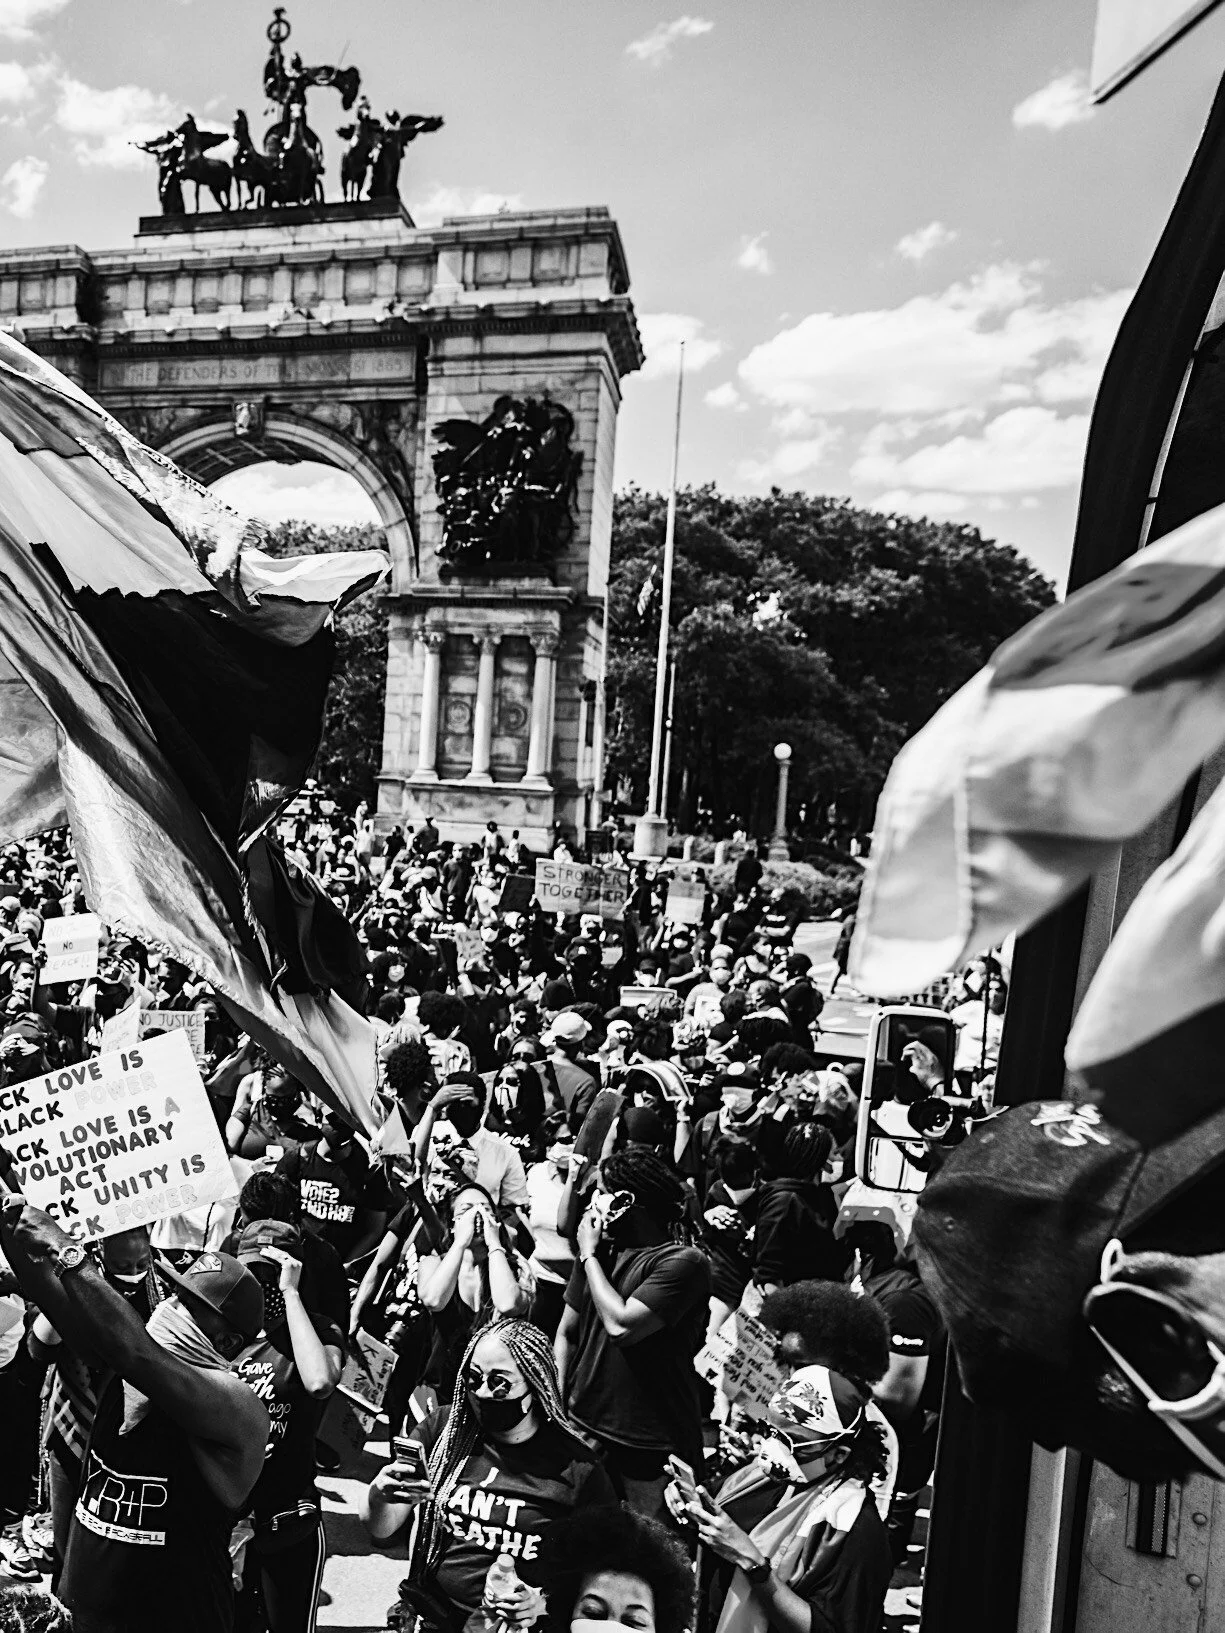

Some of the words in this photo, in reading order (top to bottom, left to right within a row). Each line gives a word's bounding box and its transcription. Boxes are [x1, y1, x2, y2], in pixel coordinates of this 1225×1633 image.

[539, 882, 624, 903] TOGETHER
[543, 865, 624, 888] STRONGER
[62, 940, 74, 951] NO
[159, 1013, 204, 1028] JUSTICE
[44, 1061, 103, 1095] LOVE
[120, 1050, 144, 1071] IS
[74, 1071, 158, 1110] POWER
[59, 1115, 119, 1149] LOVE
[128, 1105, 152, 1127] IS
[164, 1096, 181, 1117] A
[15, 1120, 174, 1186] VOLUTIONARY
[60, 1163, 108, 1196] ACT
[93, 1163, 169, 1206] UNITY
[180, 1154, 206, 1177] IS
[115, 1183, 199, 1225] POWER
[238, 1356, 274, 1376] Gave
[478, 1466, 500, 1488] I
[447, 1484, 526, 1528] AN'T
[444, 1510, 543, 1561] EATHE
